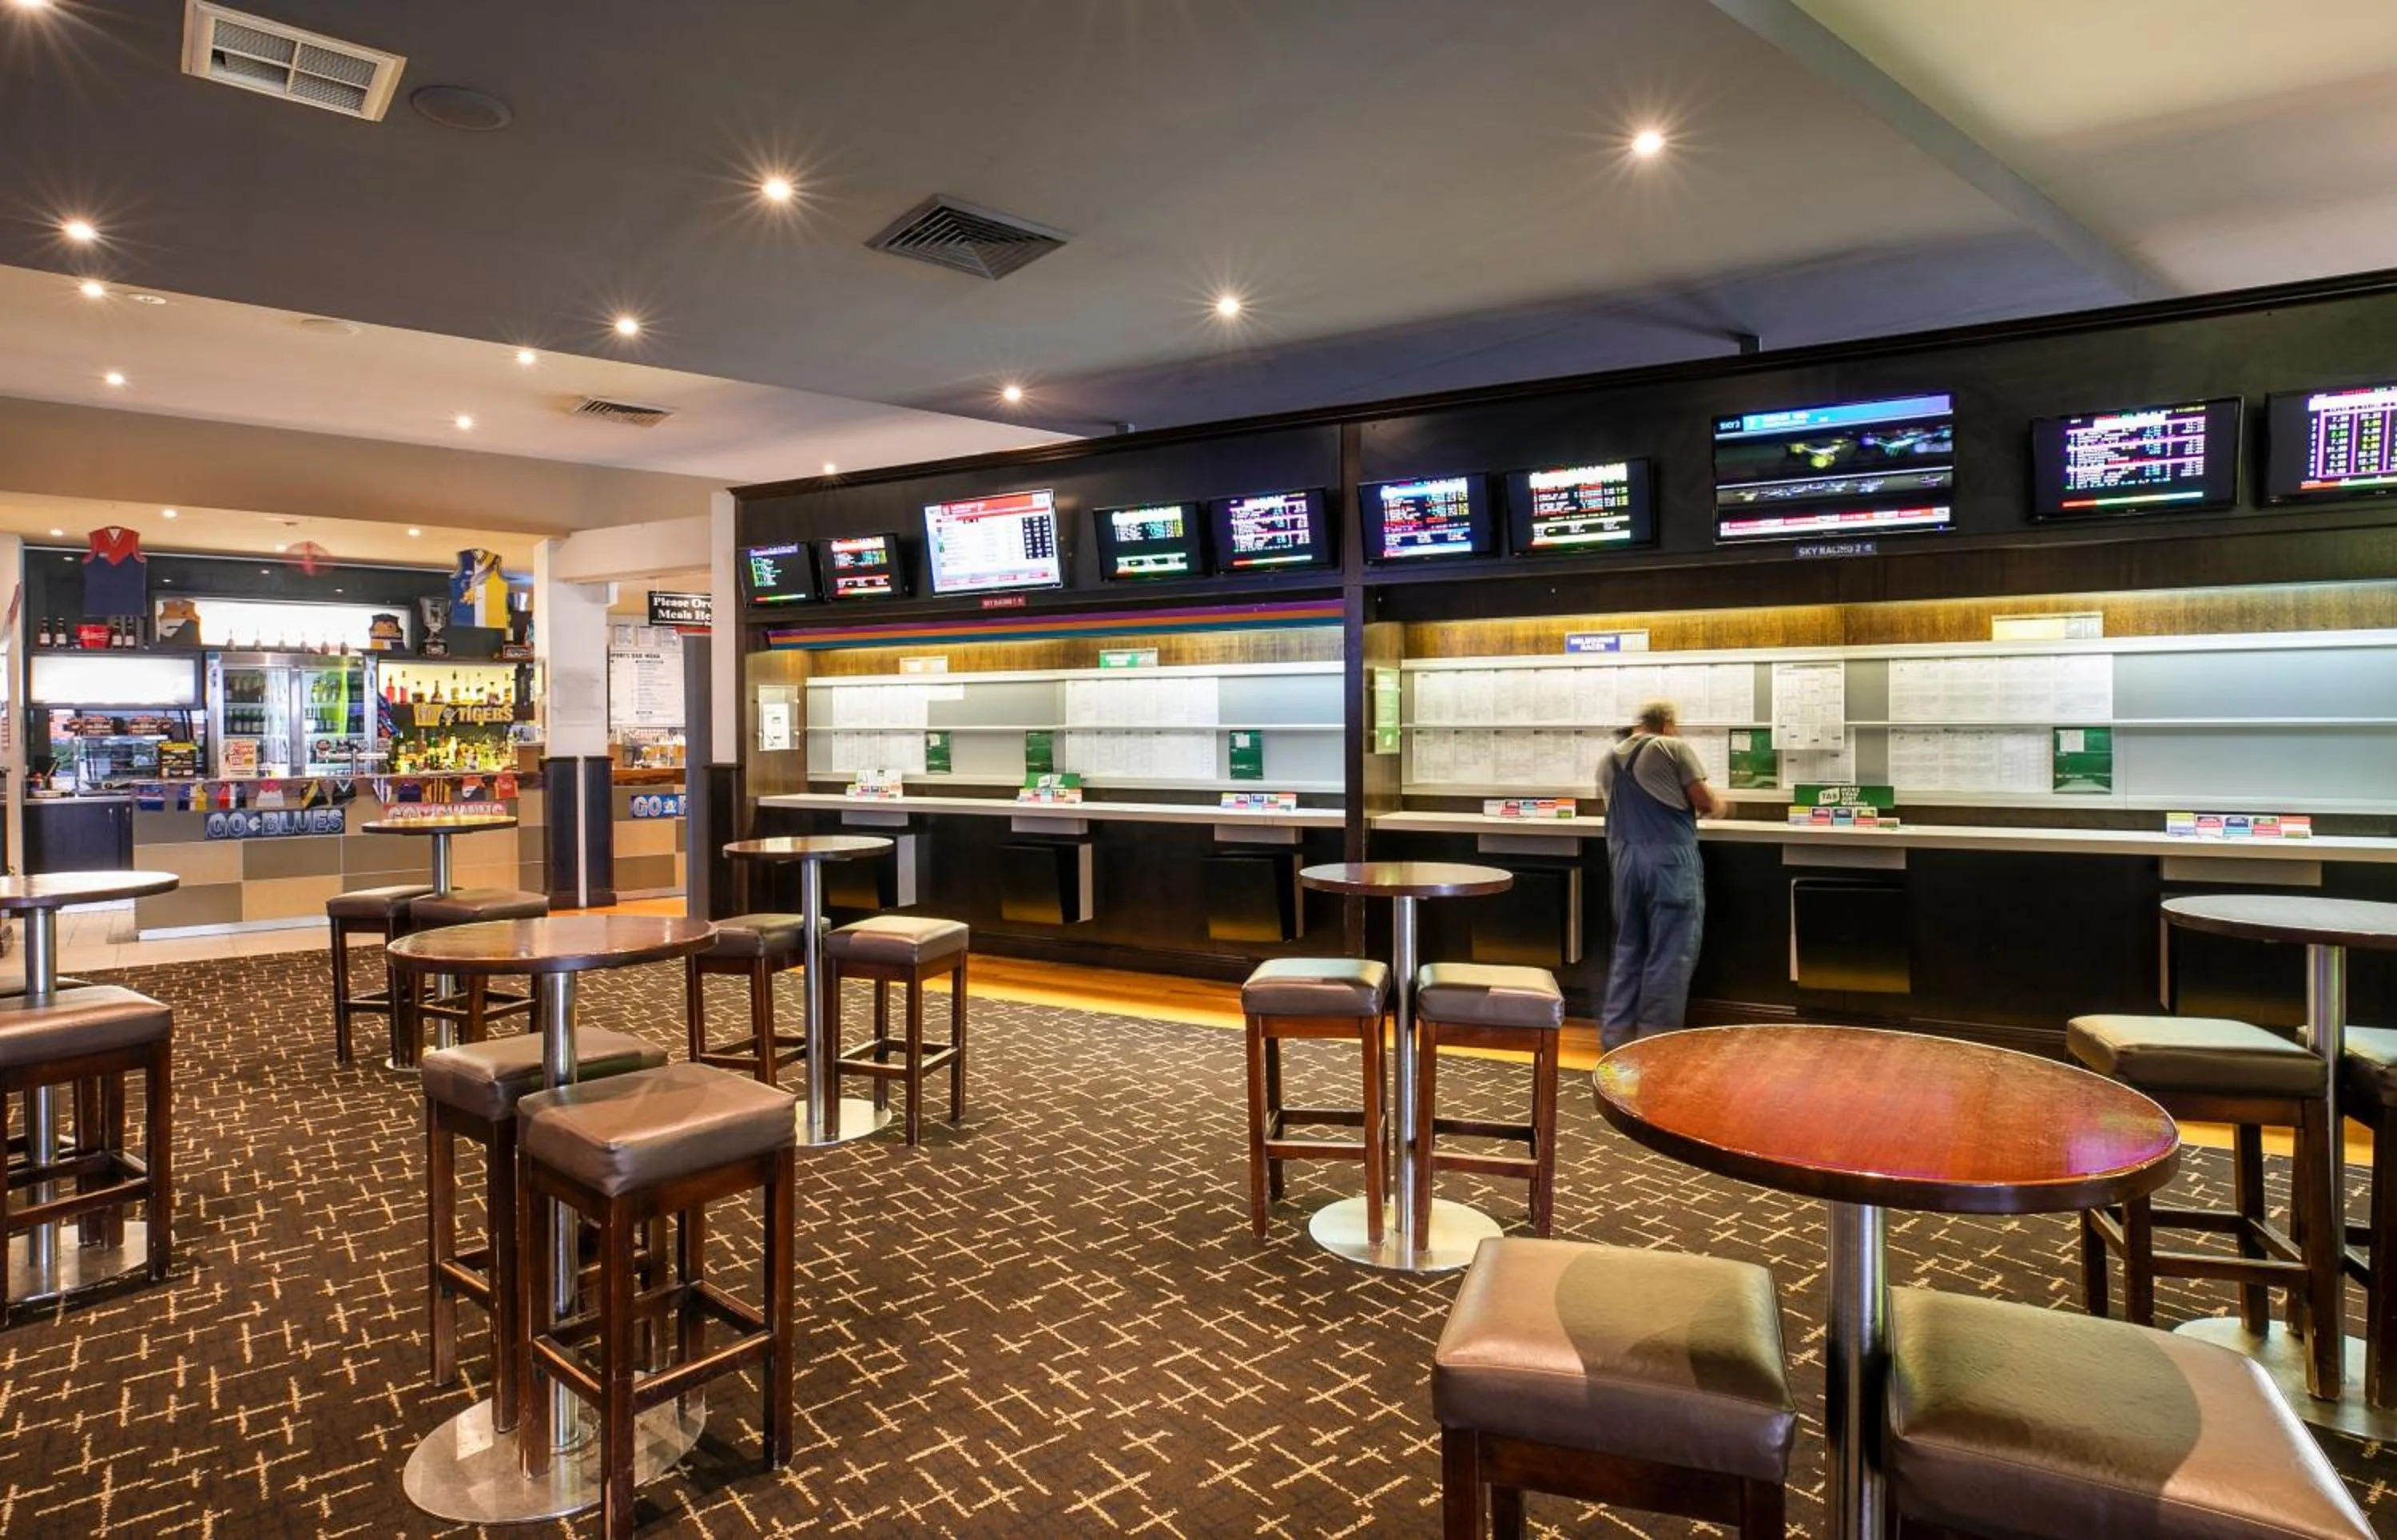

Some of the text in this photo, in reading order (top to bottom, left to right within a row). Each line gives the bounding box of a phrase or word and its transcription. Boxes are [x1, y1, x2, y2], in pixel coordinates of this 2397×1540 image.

[1799, 546, 1817, 556] SKY
[653, 597, 690, 608] Please
[658, 609, 692, 619] Meals
[458, 705, 513, 723] TIGERS
[634, 796, 662, 816] GO
[207, 809, 344, 838] GO BLUES
